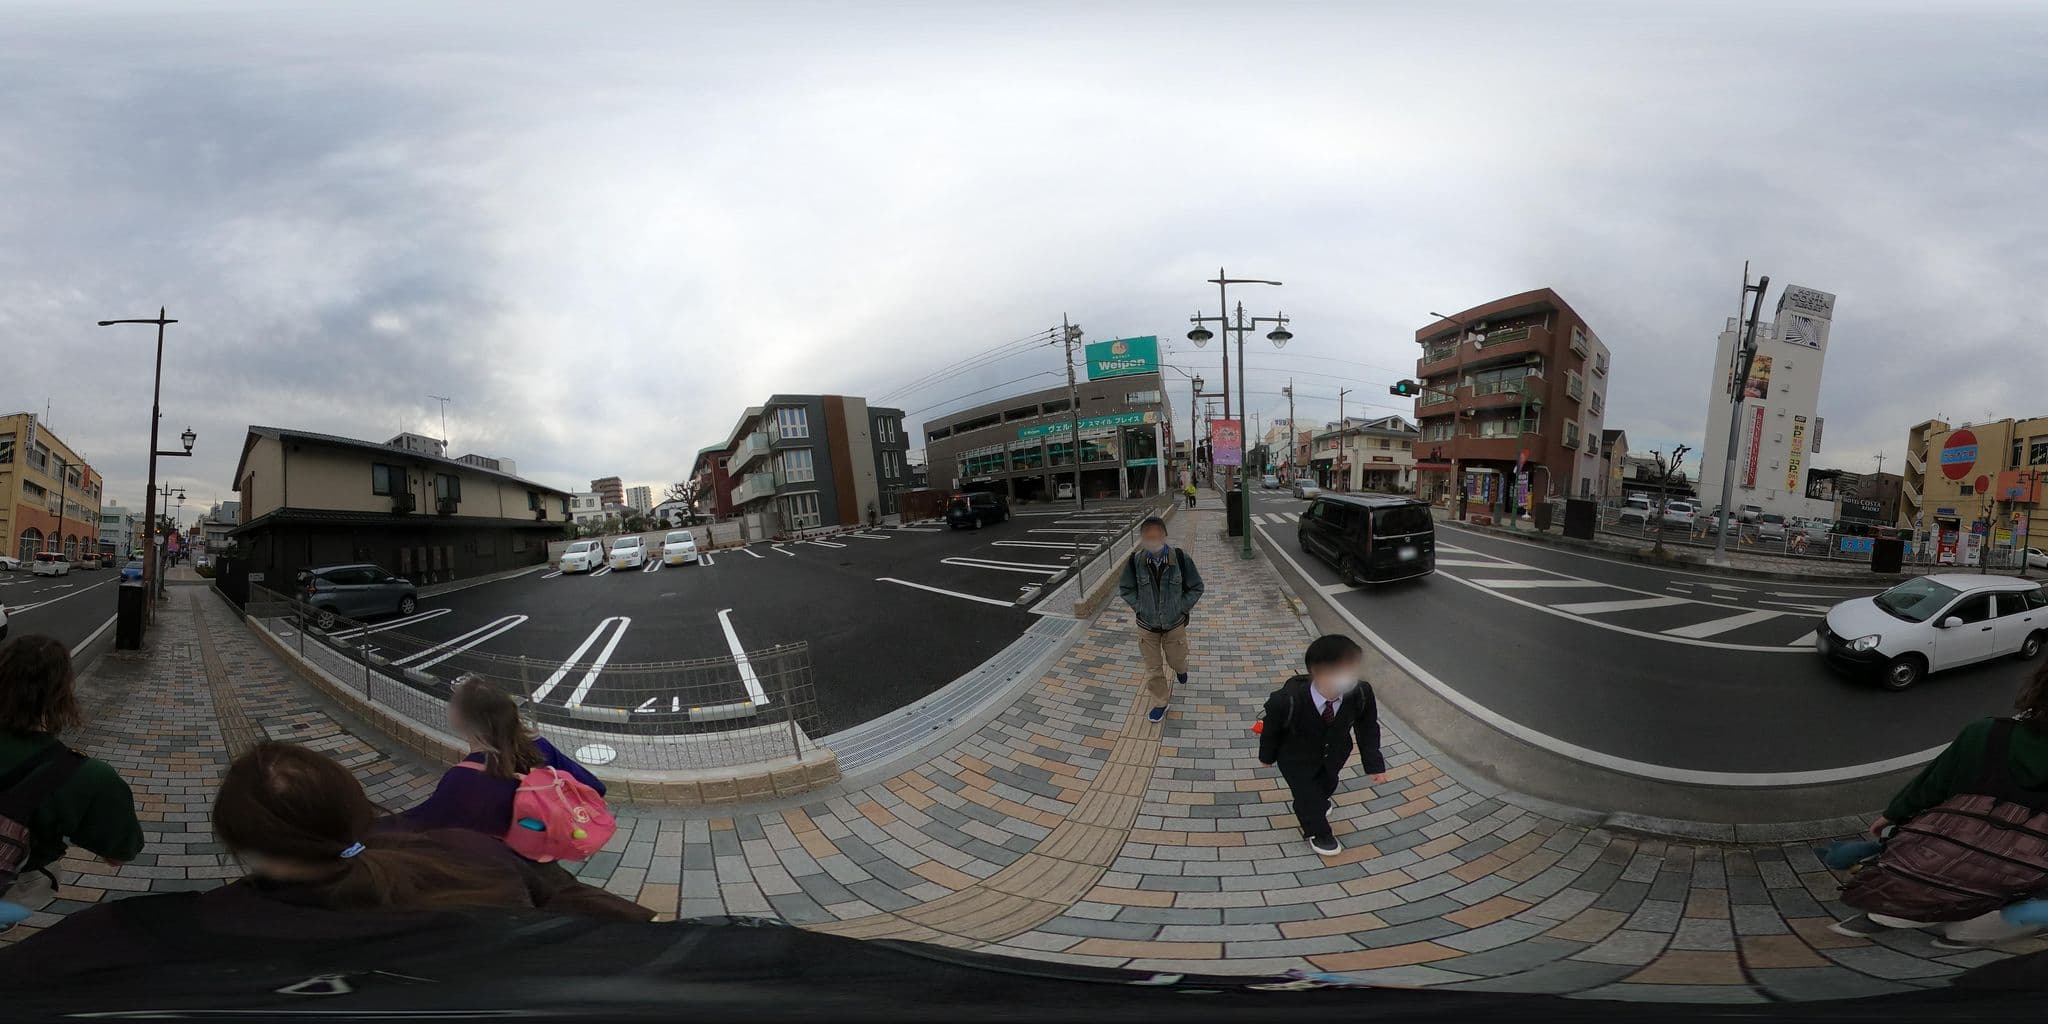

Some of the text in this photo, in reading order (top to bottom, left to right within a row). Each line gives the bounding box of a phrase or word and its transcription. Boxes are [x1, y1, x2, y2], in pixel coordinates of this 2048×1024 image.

[1098, 359, 1146, 371] Weipen
[1088, 418, 1112, 428] スマイル
[1860, 499, 1882, 508] COSTA
